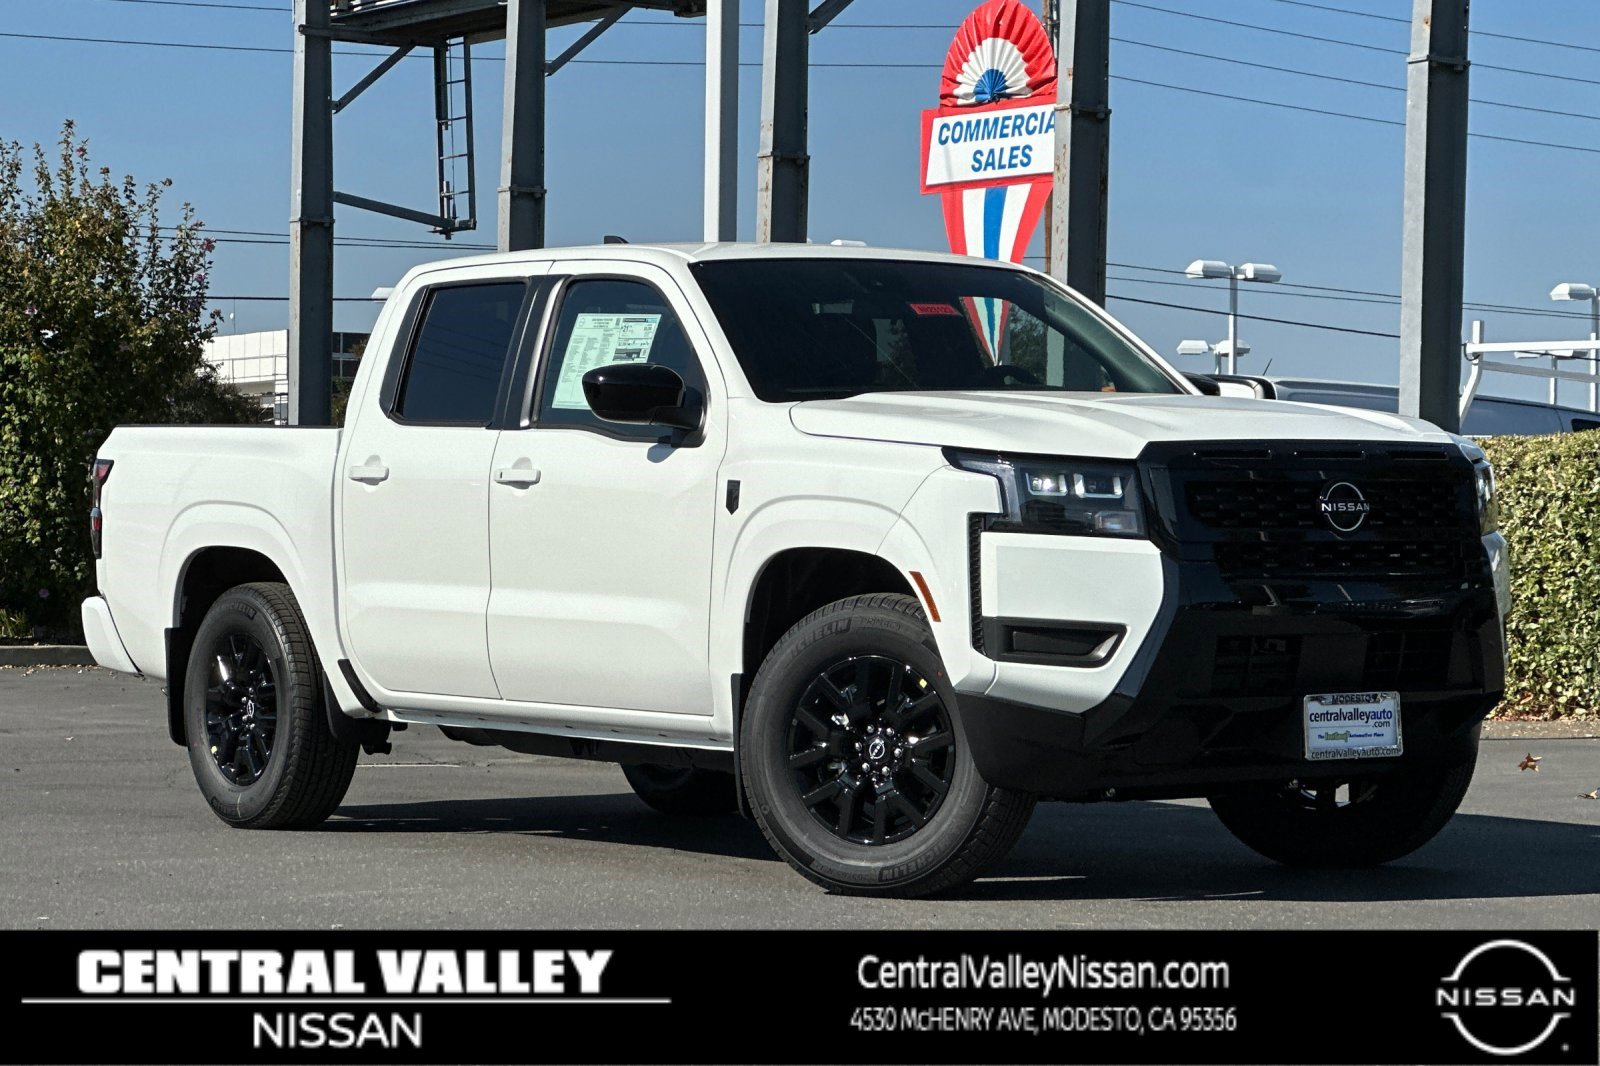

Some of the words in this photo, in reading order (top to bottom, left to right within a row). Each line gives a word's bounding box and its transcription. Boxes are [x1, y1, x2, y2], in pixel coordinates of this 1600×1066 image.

[938, 111, 1055, 146] COMMERCIA
[971, 144, 1033, 173] SALES
[1321, 502, 1370, 512] NISSAN
[1309, 708, 1393, 724] centralvalleyauto
[1372, 720, 1391, 728] .com
[1311, 747, 1398, 759] centralvalleyauto.com
